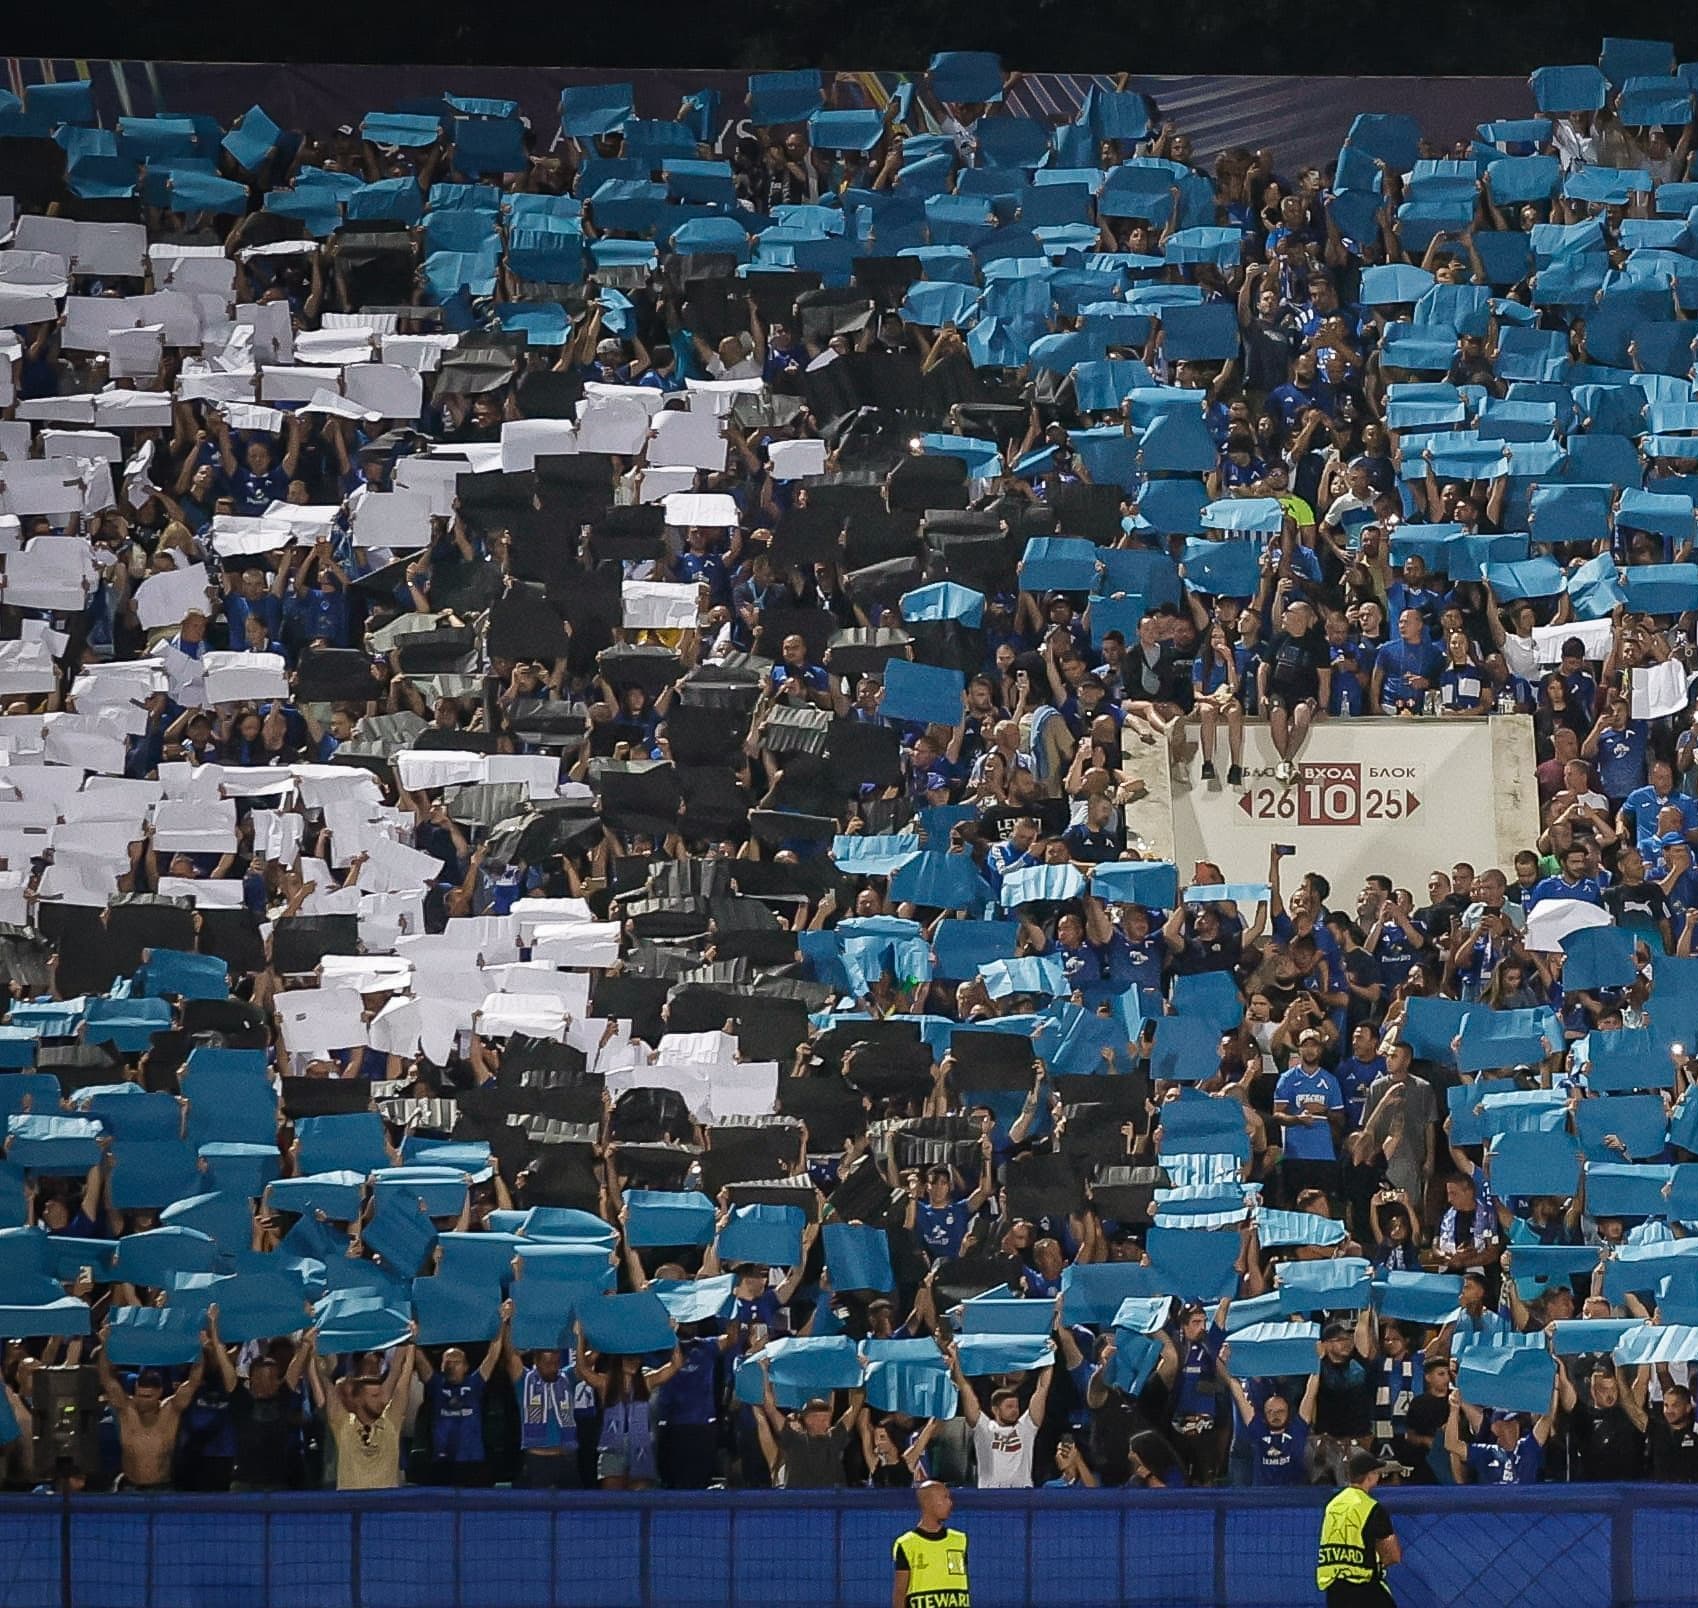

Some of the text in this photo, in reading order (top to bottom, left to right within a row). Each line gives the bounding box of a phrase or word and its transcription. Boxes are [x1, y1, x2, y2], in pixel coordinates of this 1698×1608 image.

[1241, 767, 1278, 778] БЛО
[1304, 767, 1356, 781] ВХОД
[1369, 767, 1416, 778] БЛОК
[1257, 788, 1296, 819] 26
[1304, 783, 1357, 821] 10
[1366, 788, 1403, 819] 25
